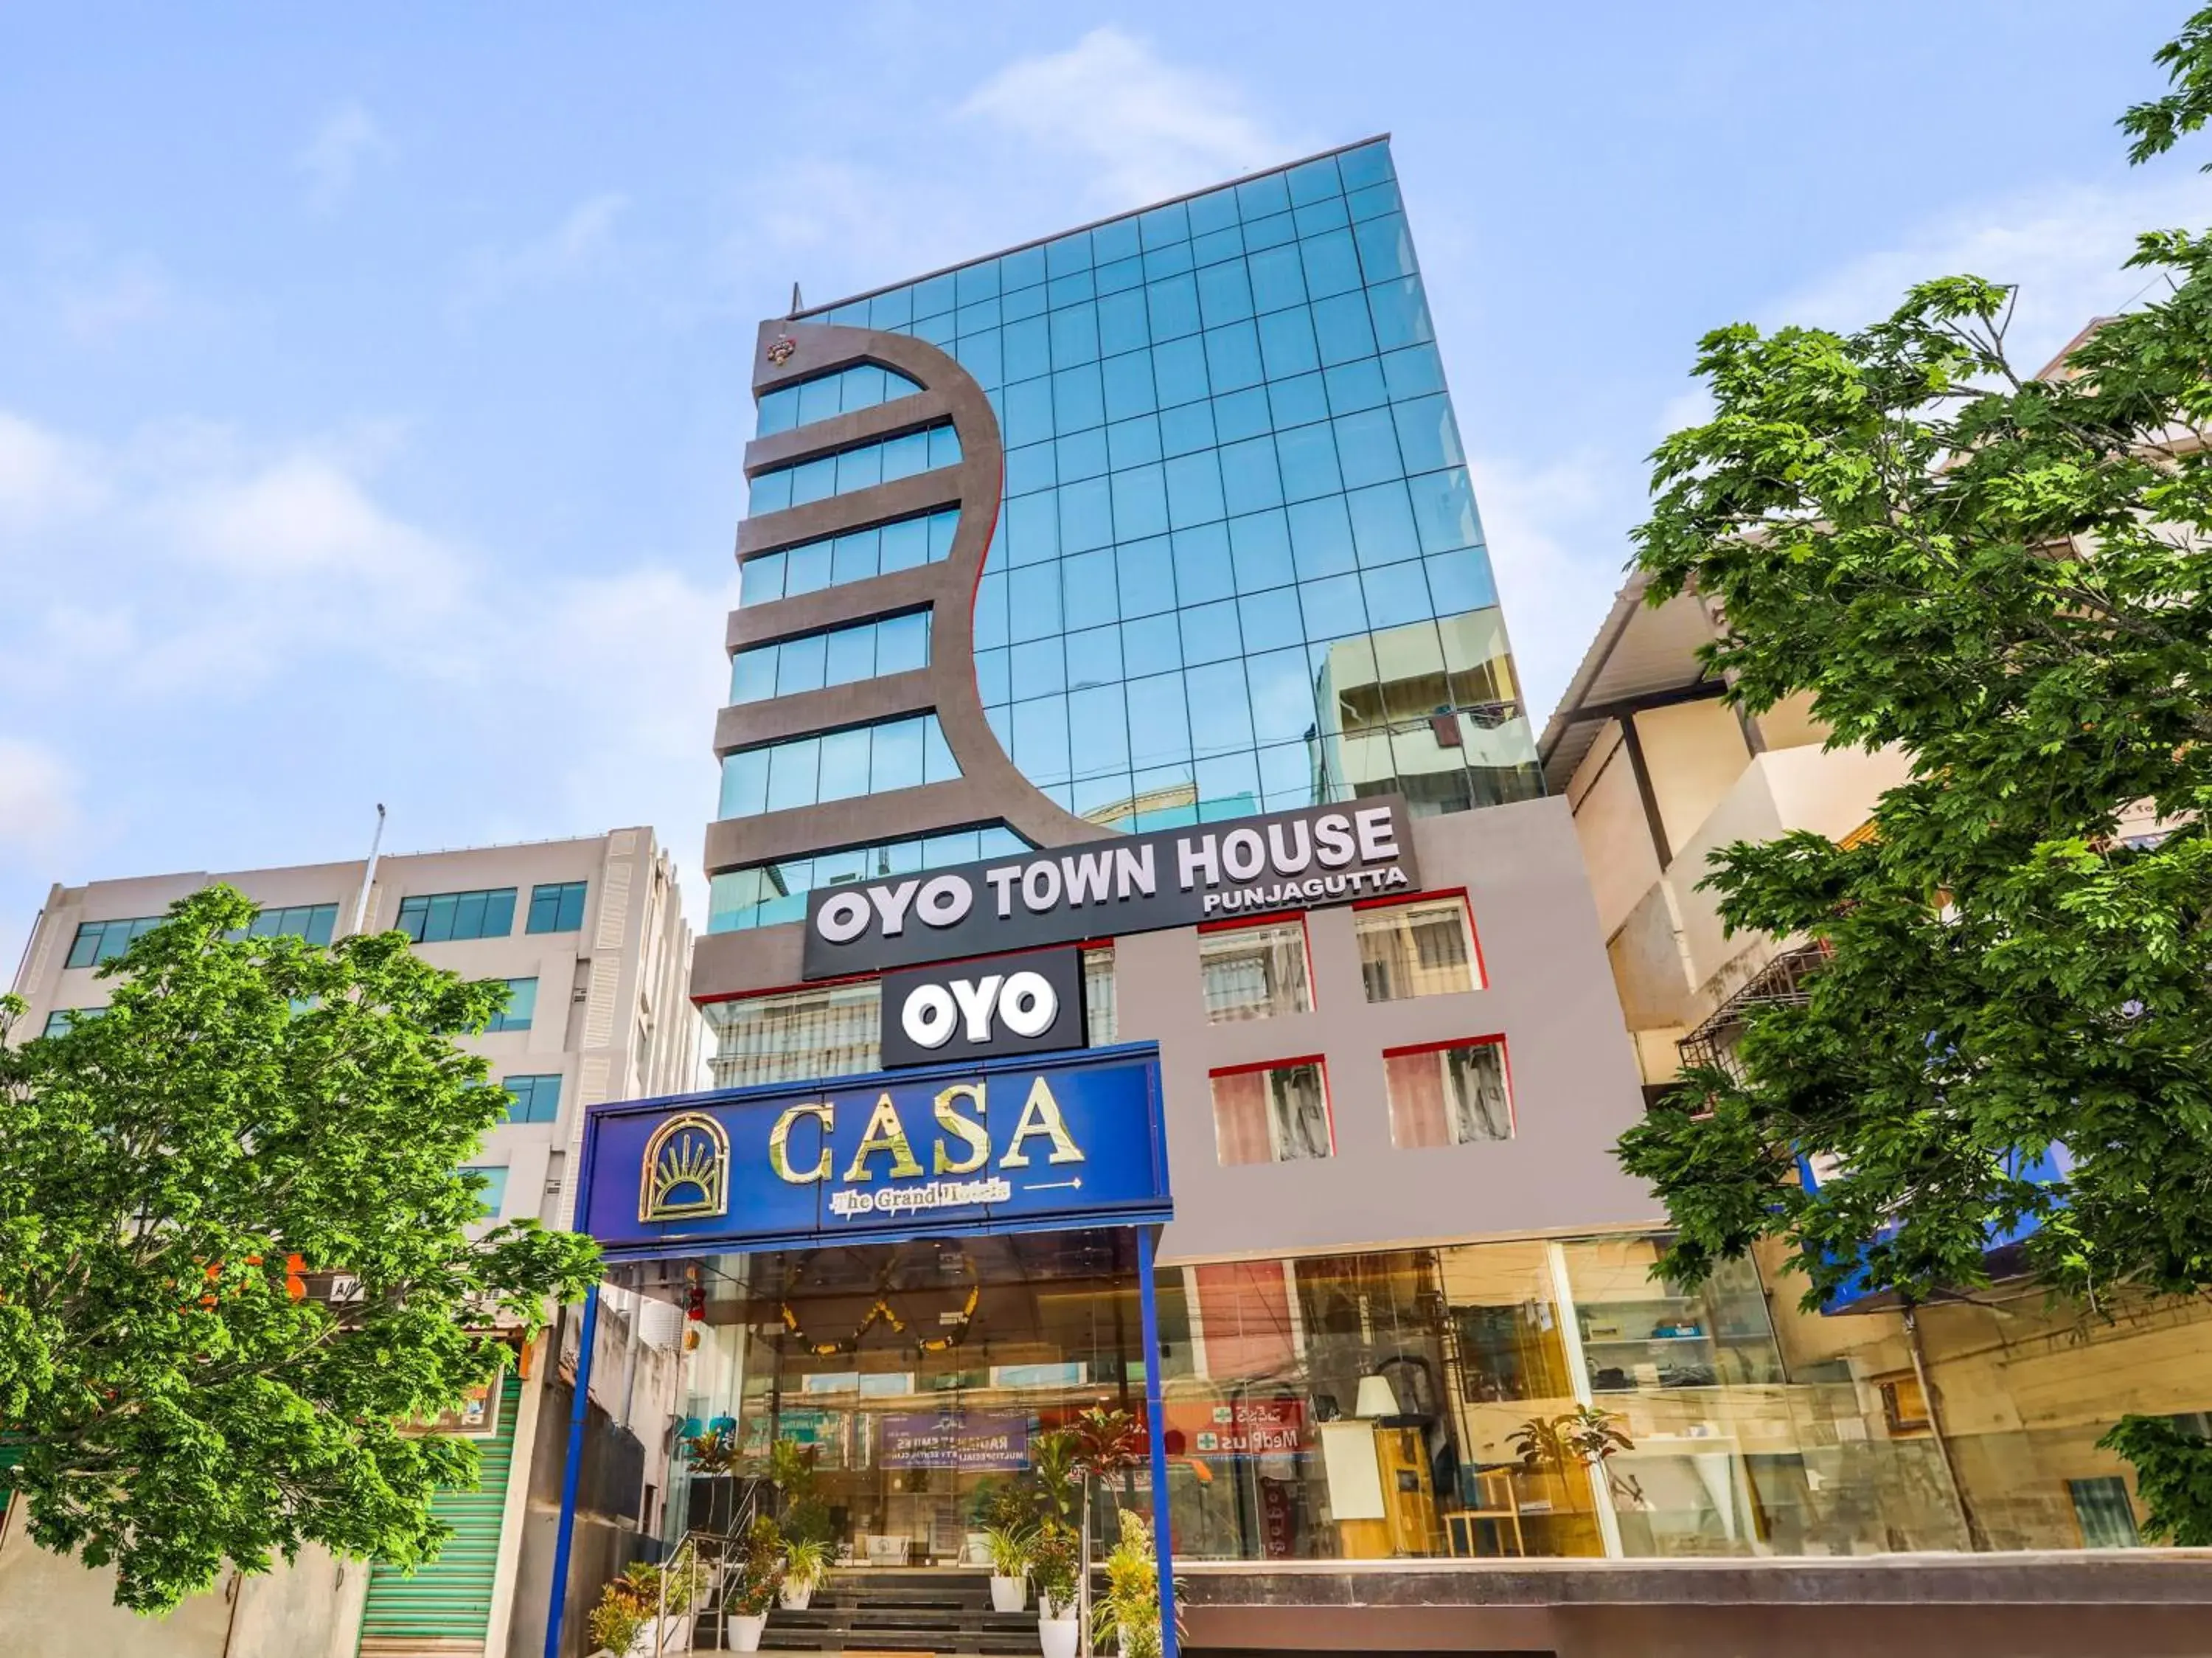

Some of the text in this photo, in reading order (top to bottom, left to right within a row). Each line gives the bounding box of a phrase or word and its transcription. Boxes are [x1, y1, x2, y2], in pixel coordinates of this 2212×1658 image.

[816, 806, 1401, 943] OYO TOWN HOUSE
[1203, 867, 1408, 915] PUNJAGUTTA
[902, 971, 1058, 1048] OYO
[768, 1076, 1085, 1184] CASA
[877, 1187, 936, 1207] Grand
[944, 1182, 1009, 1201] Hos
